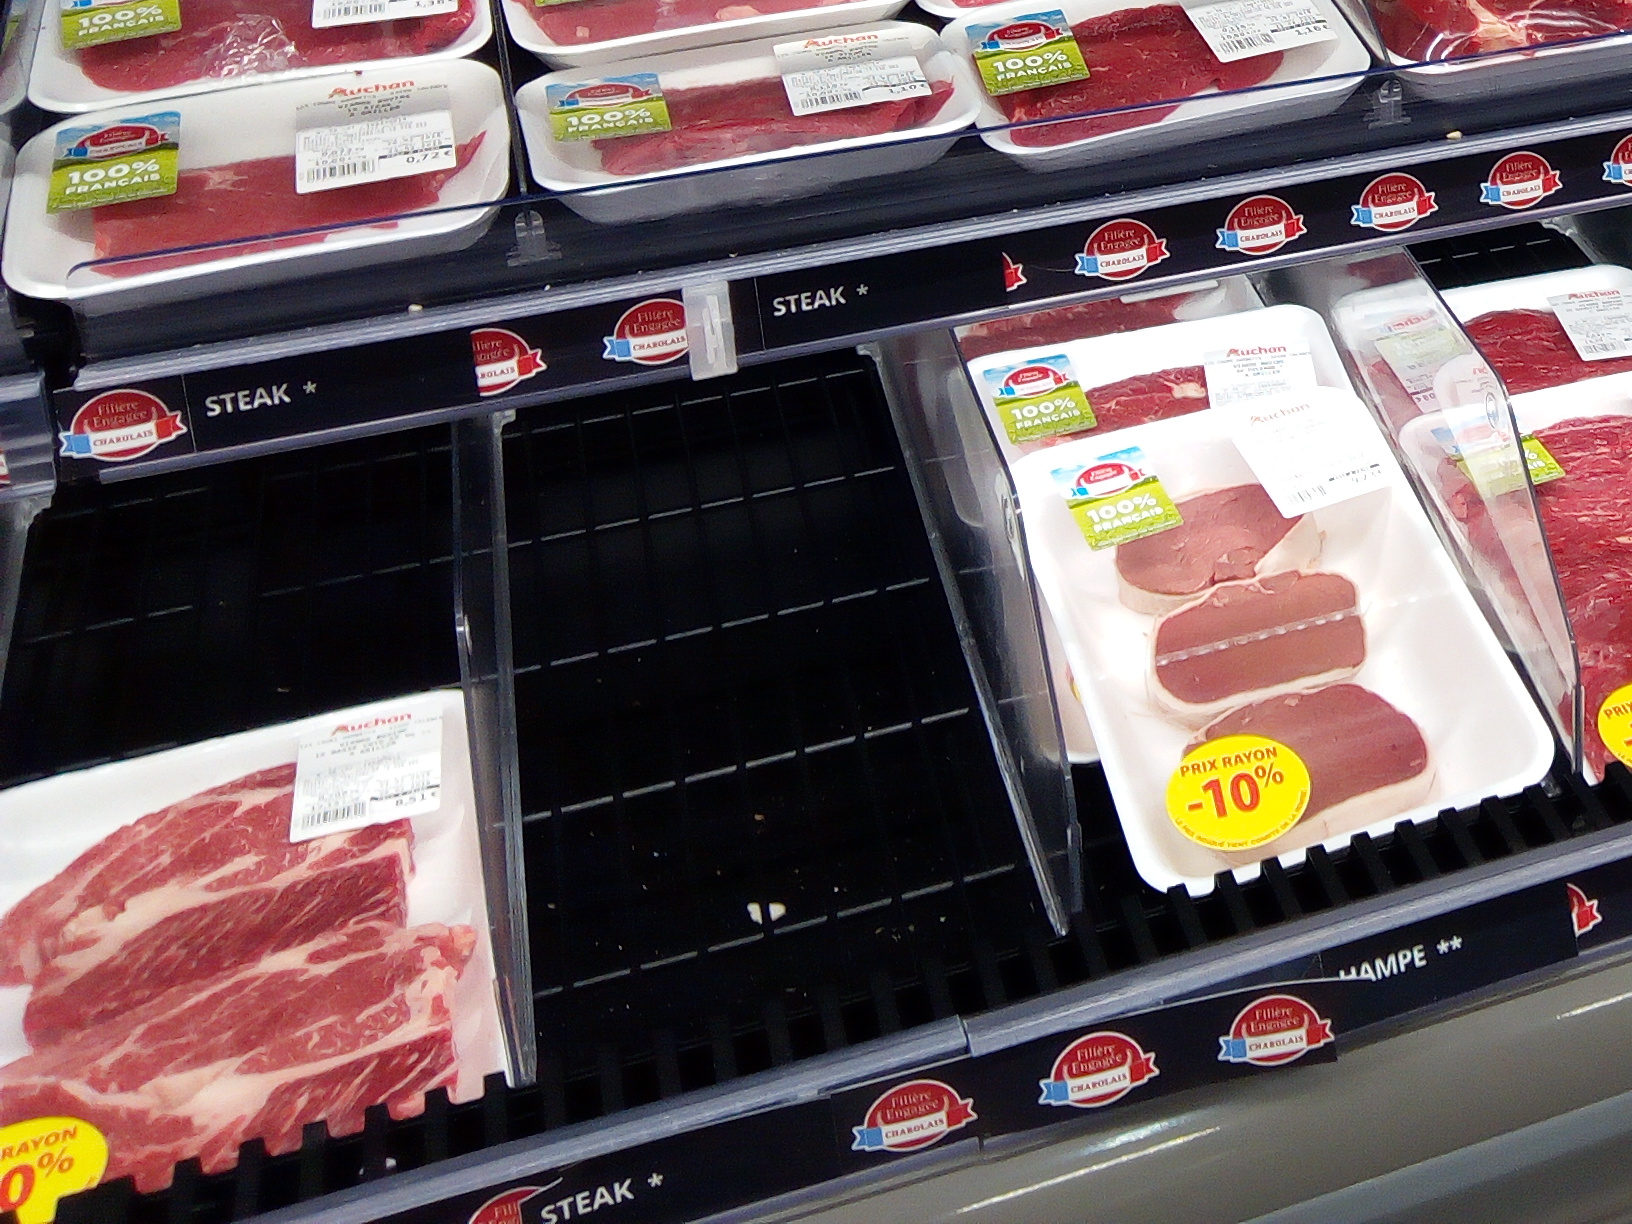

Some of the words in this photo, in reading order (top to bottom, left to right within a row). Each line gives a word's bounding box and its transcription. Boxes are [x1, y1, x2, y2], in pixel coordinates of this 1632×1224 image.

[78, 5, 163, 28] 100%
[78, 15, 164, 36] FRANÇAIS
[804, 34, 878, 48] Auchan
[992, 51, 1068, 73] 100%
[996, 61, 1073, 81] FRANÇAIS
[328, 80, 415, 99] Auchan
[567, 108, 650, 126] 100%
[568, 118, 653, 133] FRANÇAIS
[68, 158, 160, 184] 100%
[65, 172, 160, 196] FRANÇAIS
[1502, 185, 1540, 197] CHAROLAIS
[1374, 207, 1415, 219] CHAROLAIS
[1104, 229, 1135, 240] Filière
[1240, 230, 1282, 242] CHAROLAIS
[1100, 255, 1144, 268] CHAROLAIS
[773, 286, 846, 317] STEAK
[1568, 289, 1620, 300] Auchan
[633, 335, 686, 352] CHAROLAIS
[1226, 345, 1286, 357] Auchan
[97, 400, 138, 413] Filière
[205, 383, 291, 417] STEAK
[1010, 397, 1075, 420] 100%
[1015, 409, 1080, 429] FRANÇAIS
[1251, 404, 1310, 423] Auchan
[93, 430, 153, 446] CHAROLAIS
[1086, 493, 1157, 523] 100%
[1093, 507, 1163, 533] FRANÇAIS
[332, 711, 412, 735] Auchan
[1180, 759, 1218, 777] PRIX
[1222, 747, 1278, 768] RAYON
[1188, 763, 1284, 819] -10%
[1255, 1006, 1292, 1020] Filière
[1077, 1043, 1115, 1060] Filière
[1249, 1037, 1304, 1051] CHAROLAIS
[1071, 1074, 1127, 1093] CHAROLAIS
[891, 1092, 931, 1107] Filière
[885, 1119, 944, 1138] CHAROLAIS
[0, 1126, 78, 1160] RAYON
[541, 1178, 634, 1224] STEAK
